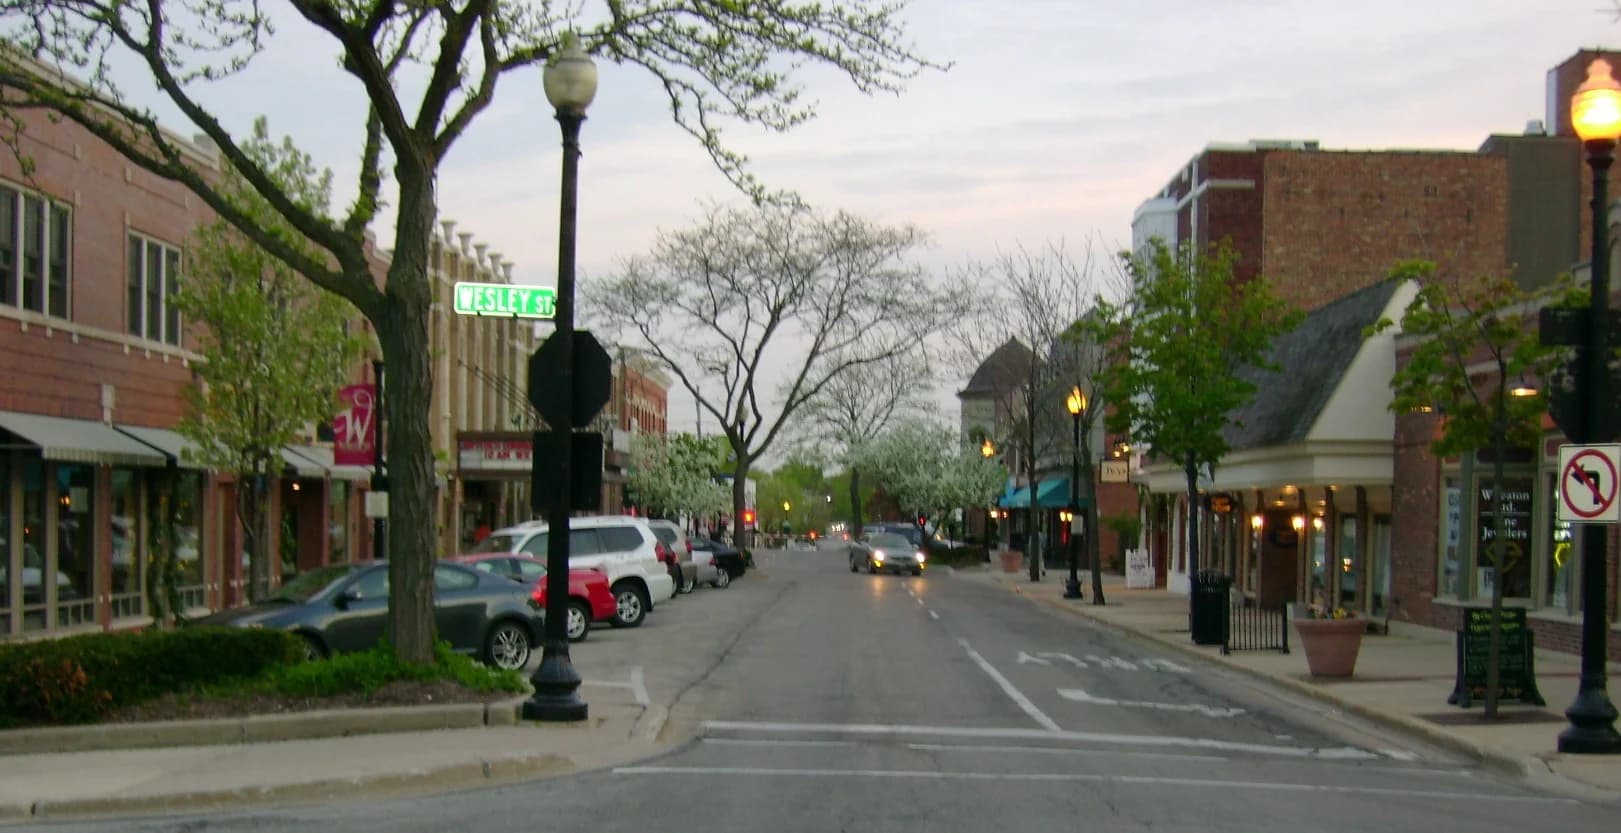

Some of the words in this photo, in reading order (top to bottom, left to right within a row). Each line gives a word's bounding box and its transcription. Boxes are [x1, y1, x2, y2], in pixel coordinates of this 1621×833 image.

[458, 286, 530, 313] WESLEY
[535, 295, 552, 313] ST
[1481, 488, 1530, 501] Weaton
